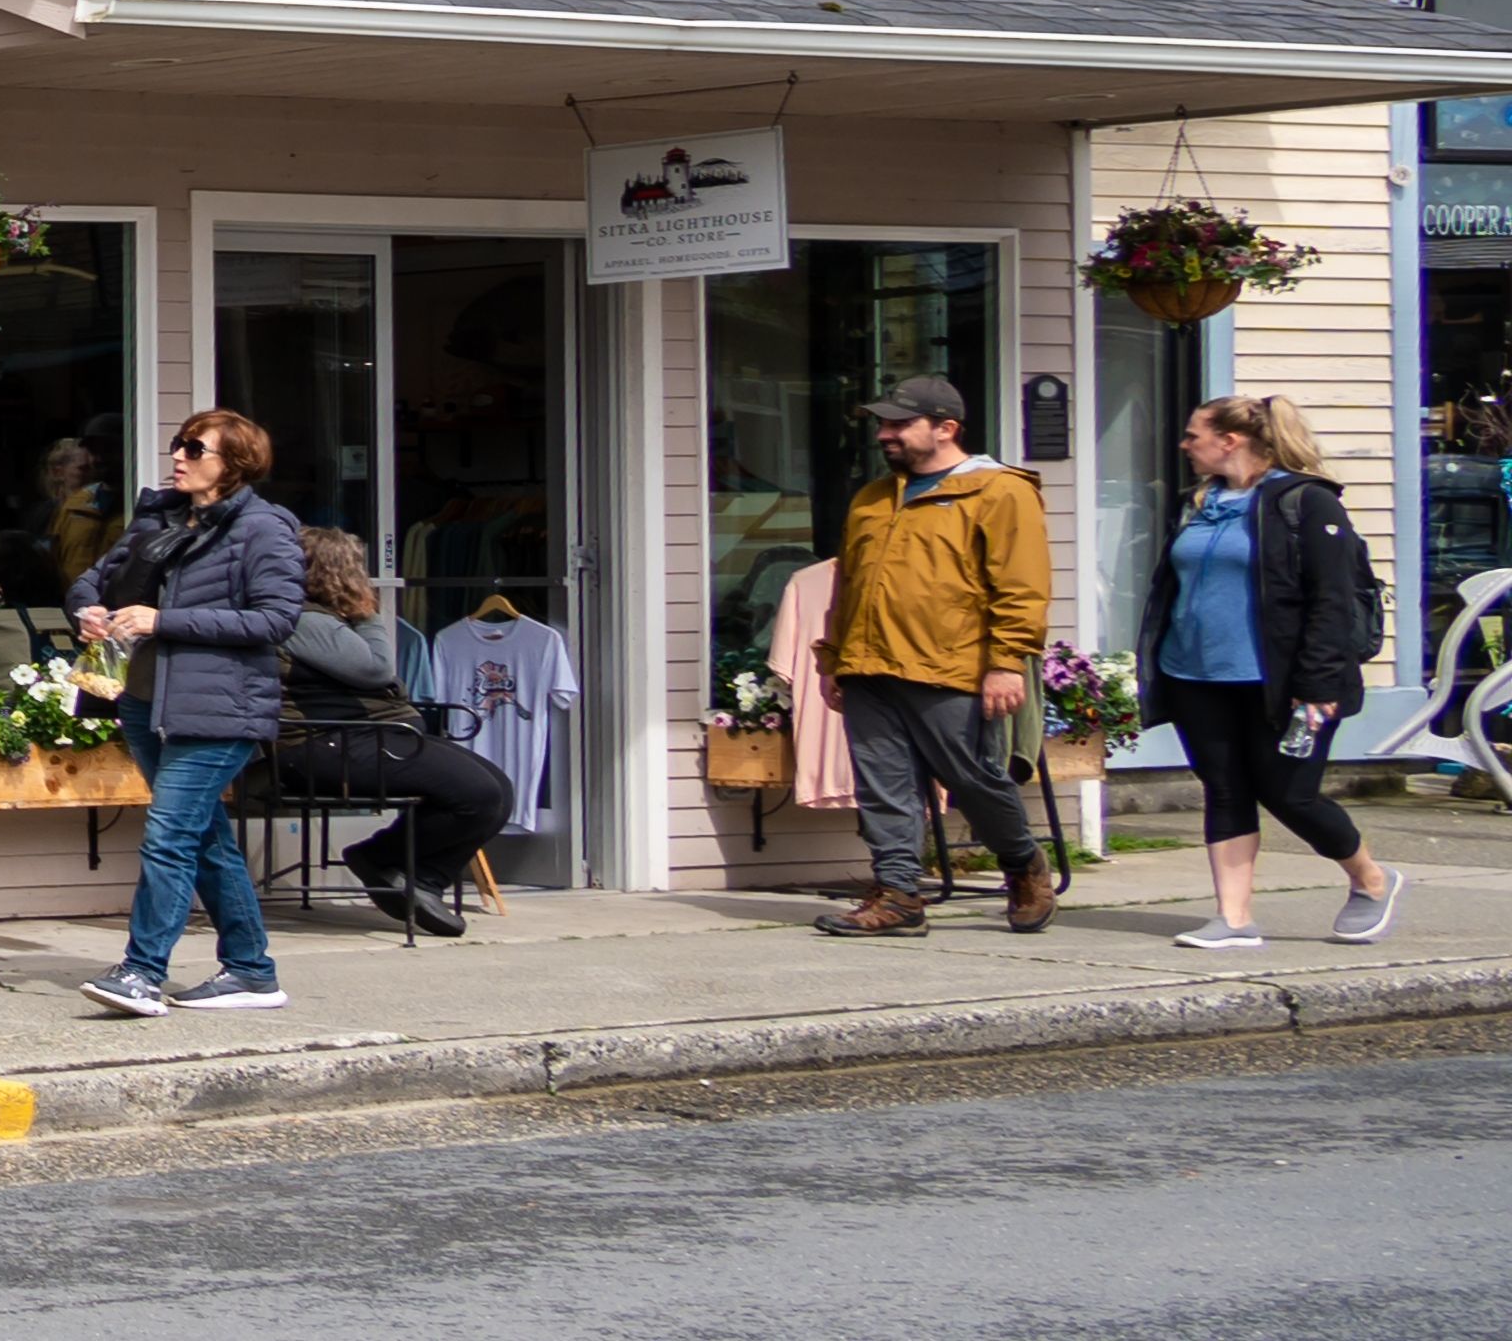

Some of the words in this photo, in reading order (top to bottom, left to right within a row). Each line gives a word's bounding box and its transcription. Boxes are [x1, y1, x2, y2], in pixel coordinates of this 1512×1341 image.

[599, 223, 649, 238] SITKA
[656, 211, 774, 232] LIGHTHOUSE
[678, 231, 726, 245] STORE
